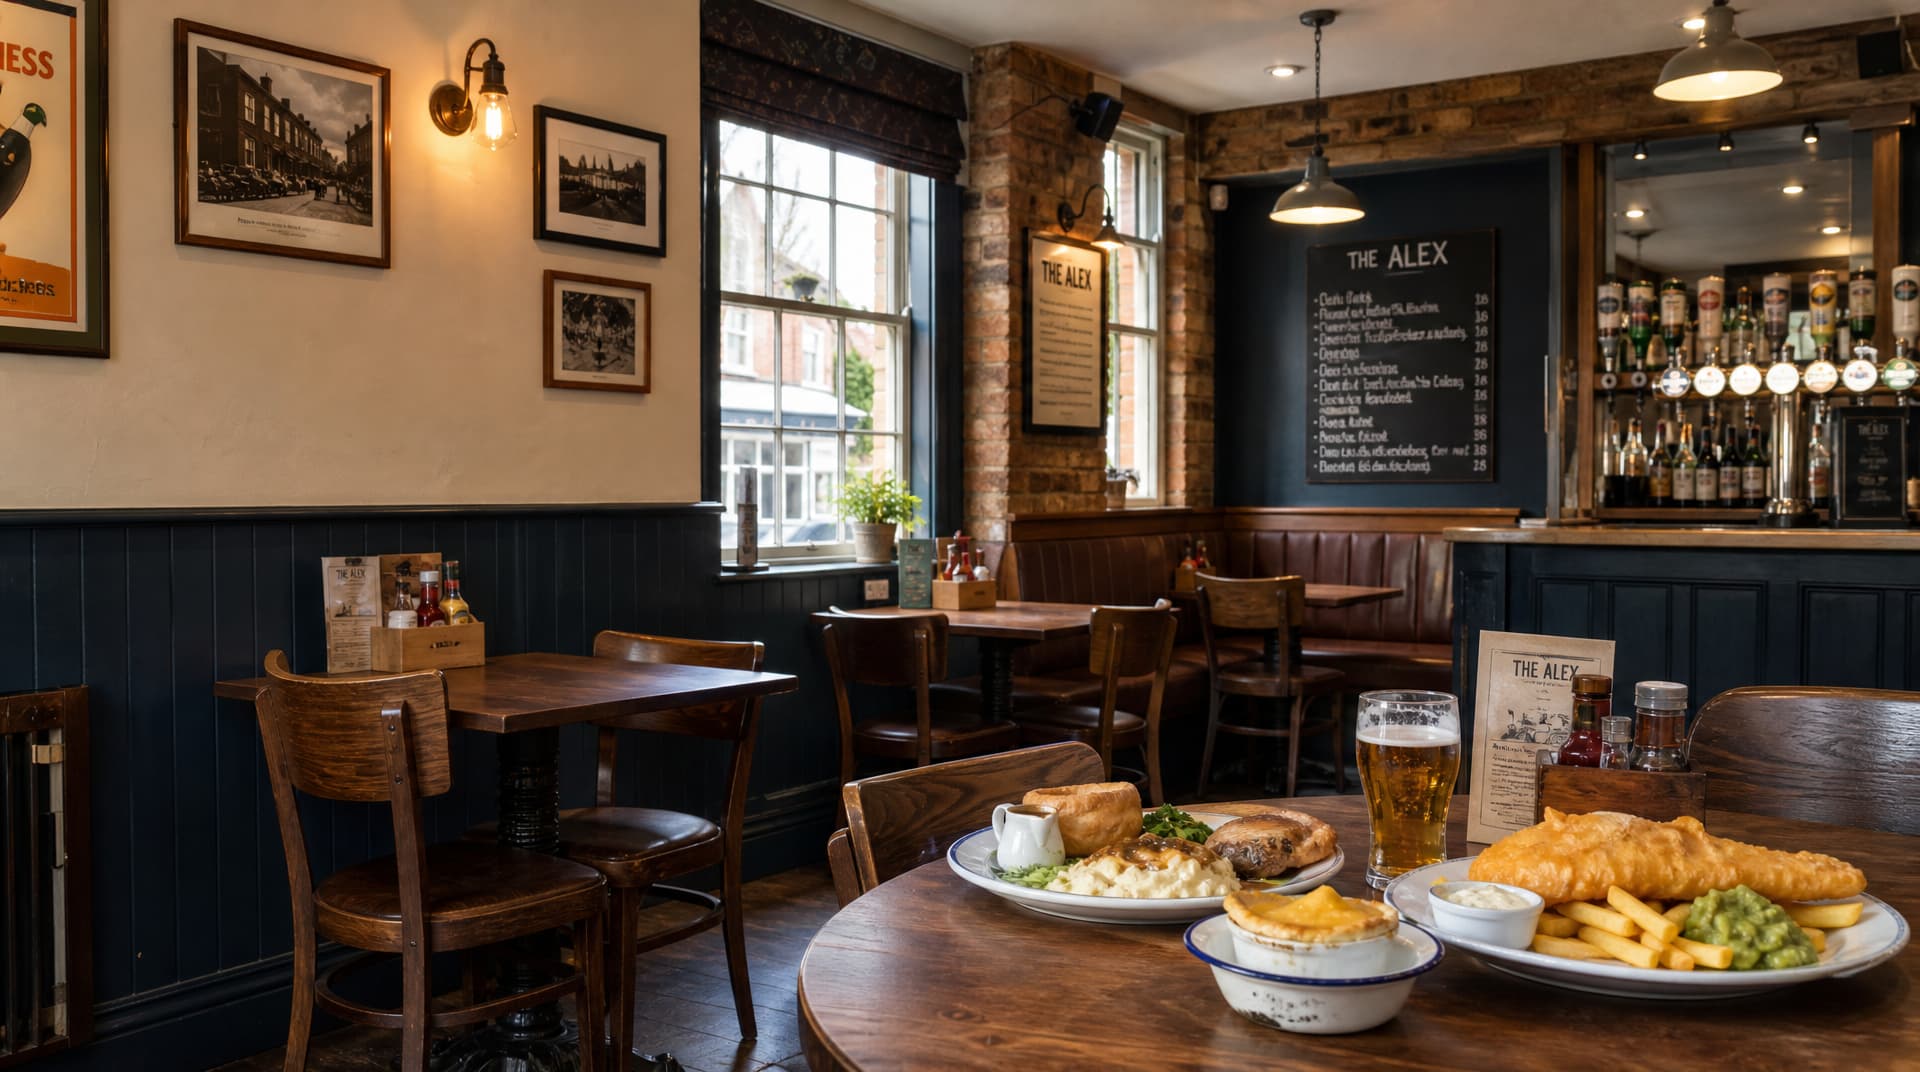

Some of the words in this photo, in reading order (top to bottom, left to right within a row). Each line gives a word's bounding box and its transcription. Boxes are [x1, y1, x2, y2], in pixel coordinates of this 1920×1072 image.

[1347, 249, 1378, 269] THE
[1387, 240, 1448, 270] ALEX
[1041, 260, 1062, 285] THE
[1065, 265, 1092, 291] ALEX
[1513, 659, 1539, 678] THE
[1543, 662, 1579, 682] ALEX
